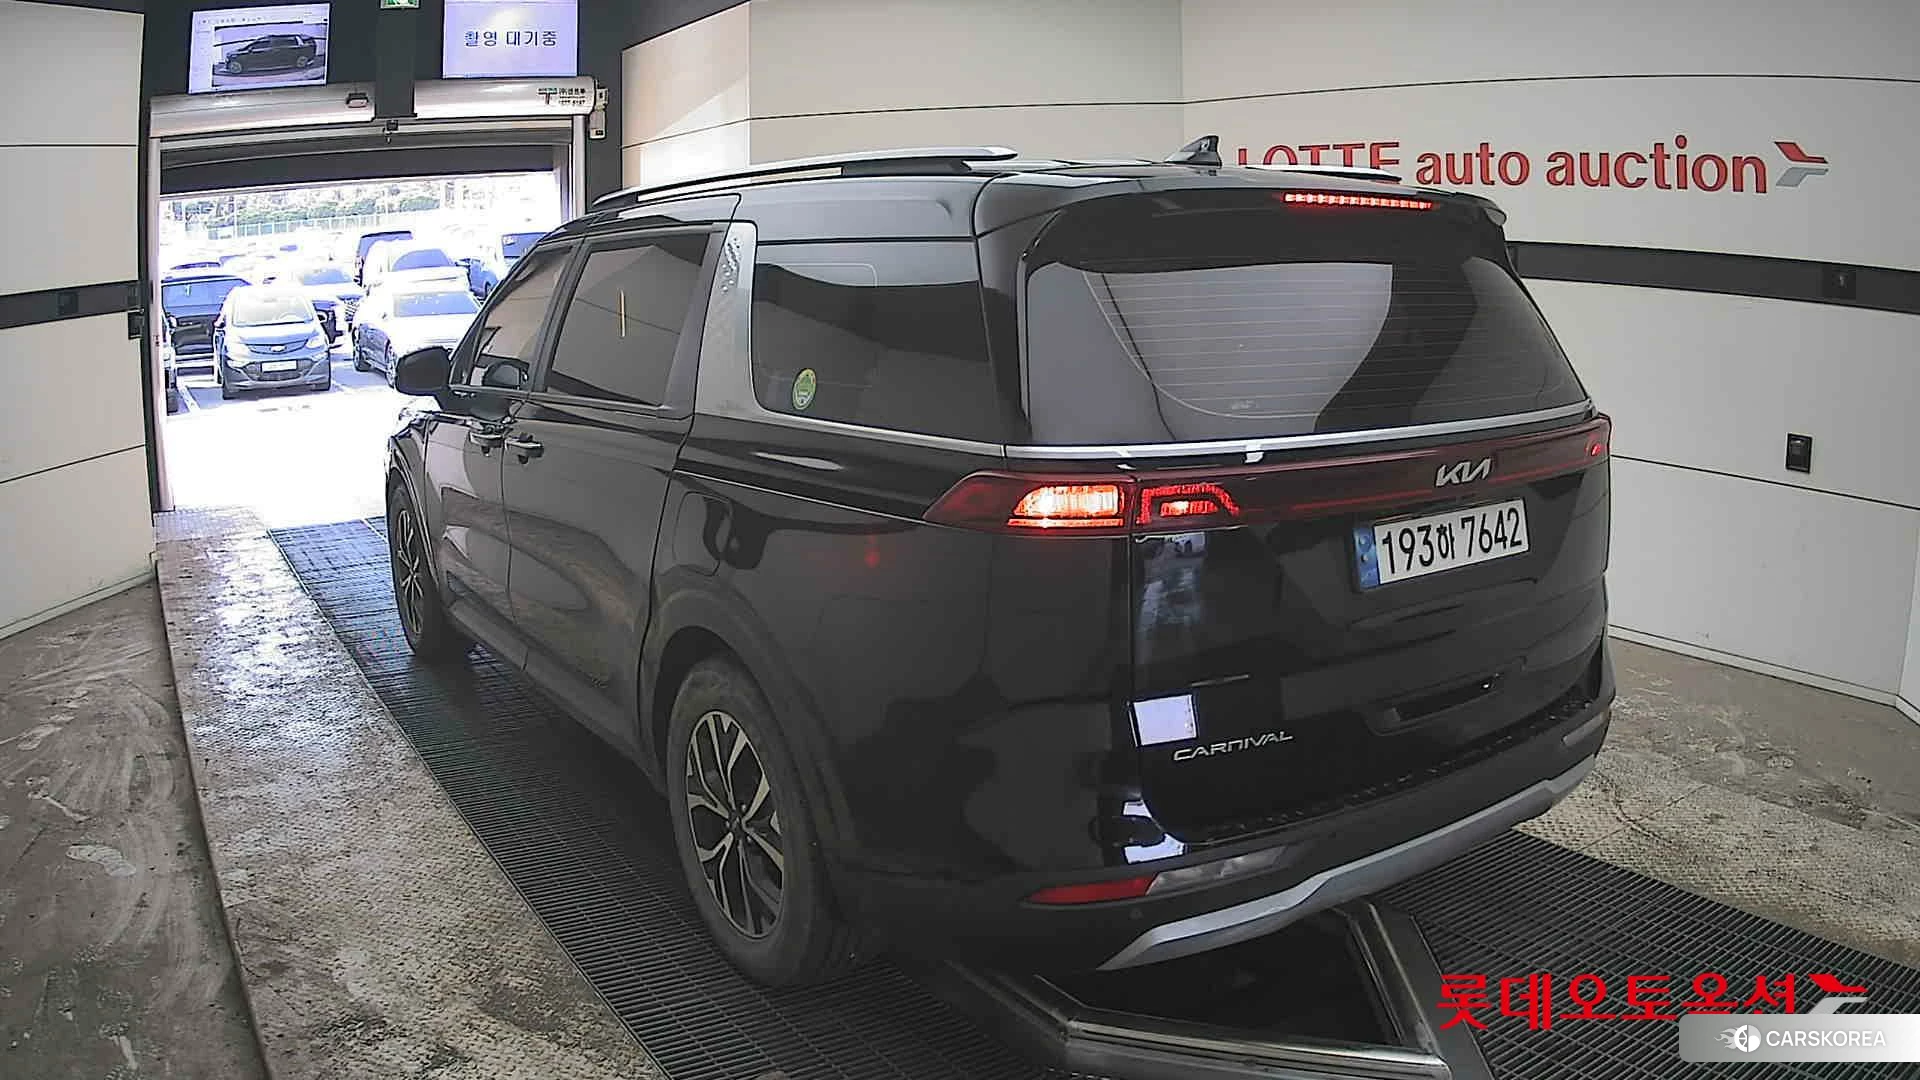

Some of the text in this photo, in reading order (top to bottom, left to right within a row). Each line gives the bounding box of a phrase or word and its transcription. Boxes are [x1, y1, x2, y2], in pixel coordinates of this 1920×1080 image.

[506, 31, 557, 47] 대기중
[1415, 142, 1530, 186] auto
[1546, 134, 1768, 194] auction
[1435, 457, 1492, 487] KIA
[1382, 507, 1522, 574] 193하 7642
[1174, 731, 1293, 761] CARNIVAL
